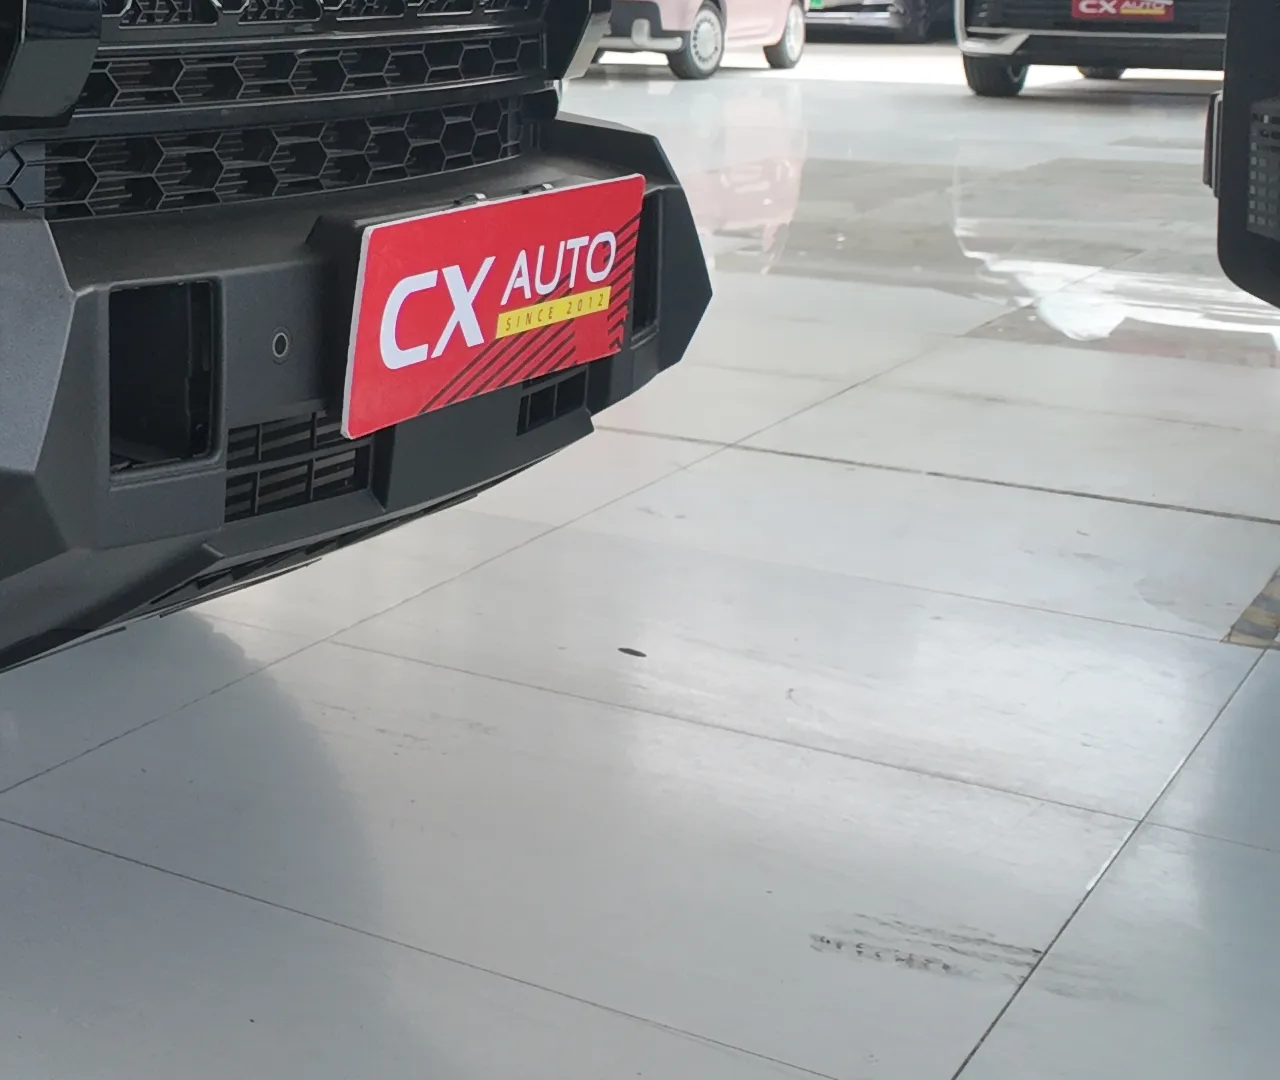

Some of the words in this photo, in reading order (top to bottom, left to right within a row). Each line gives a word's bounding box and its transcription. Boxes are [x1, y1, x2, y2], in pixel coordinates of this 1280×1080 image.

[1078, 0, 1118, 14] CX
[1120, 0, 1166, 10] AUTO
[379, 255, 497, 370] CX
[500, 231, 617, 306] AUTO
[505, 306, 554, 332] SINCE
[566, 292, 605, 316] 2012
